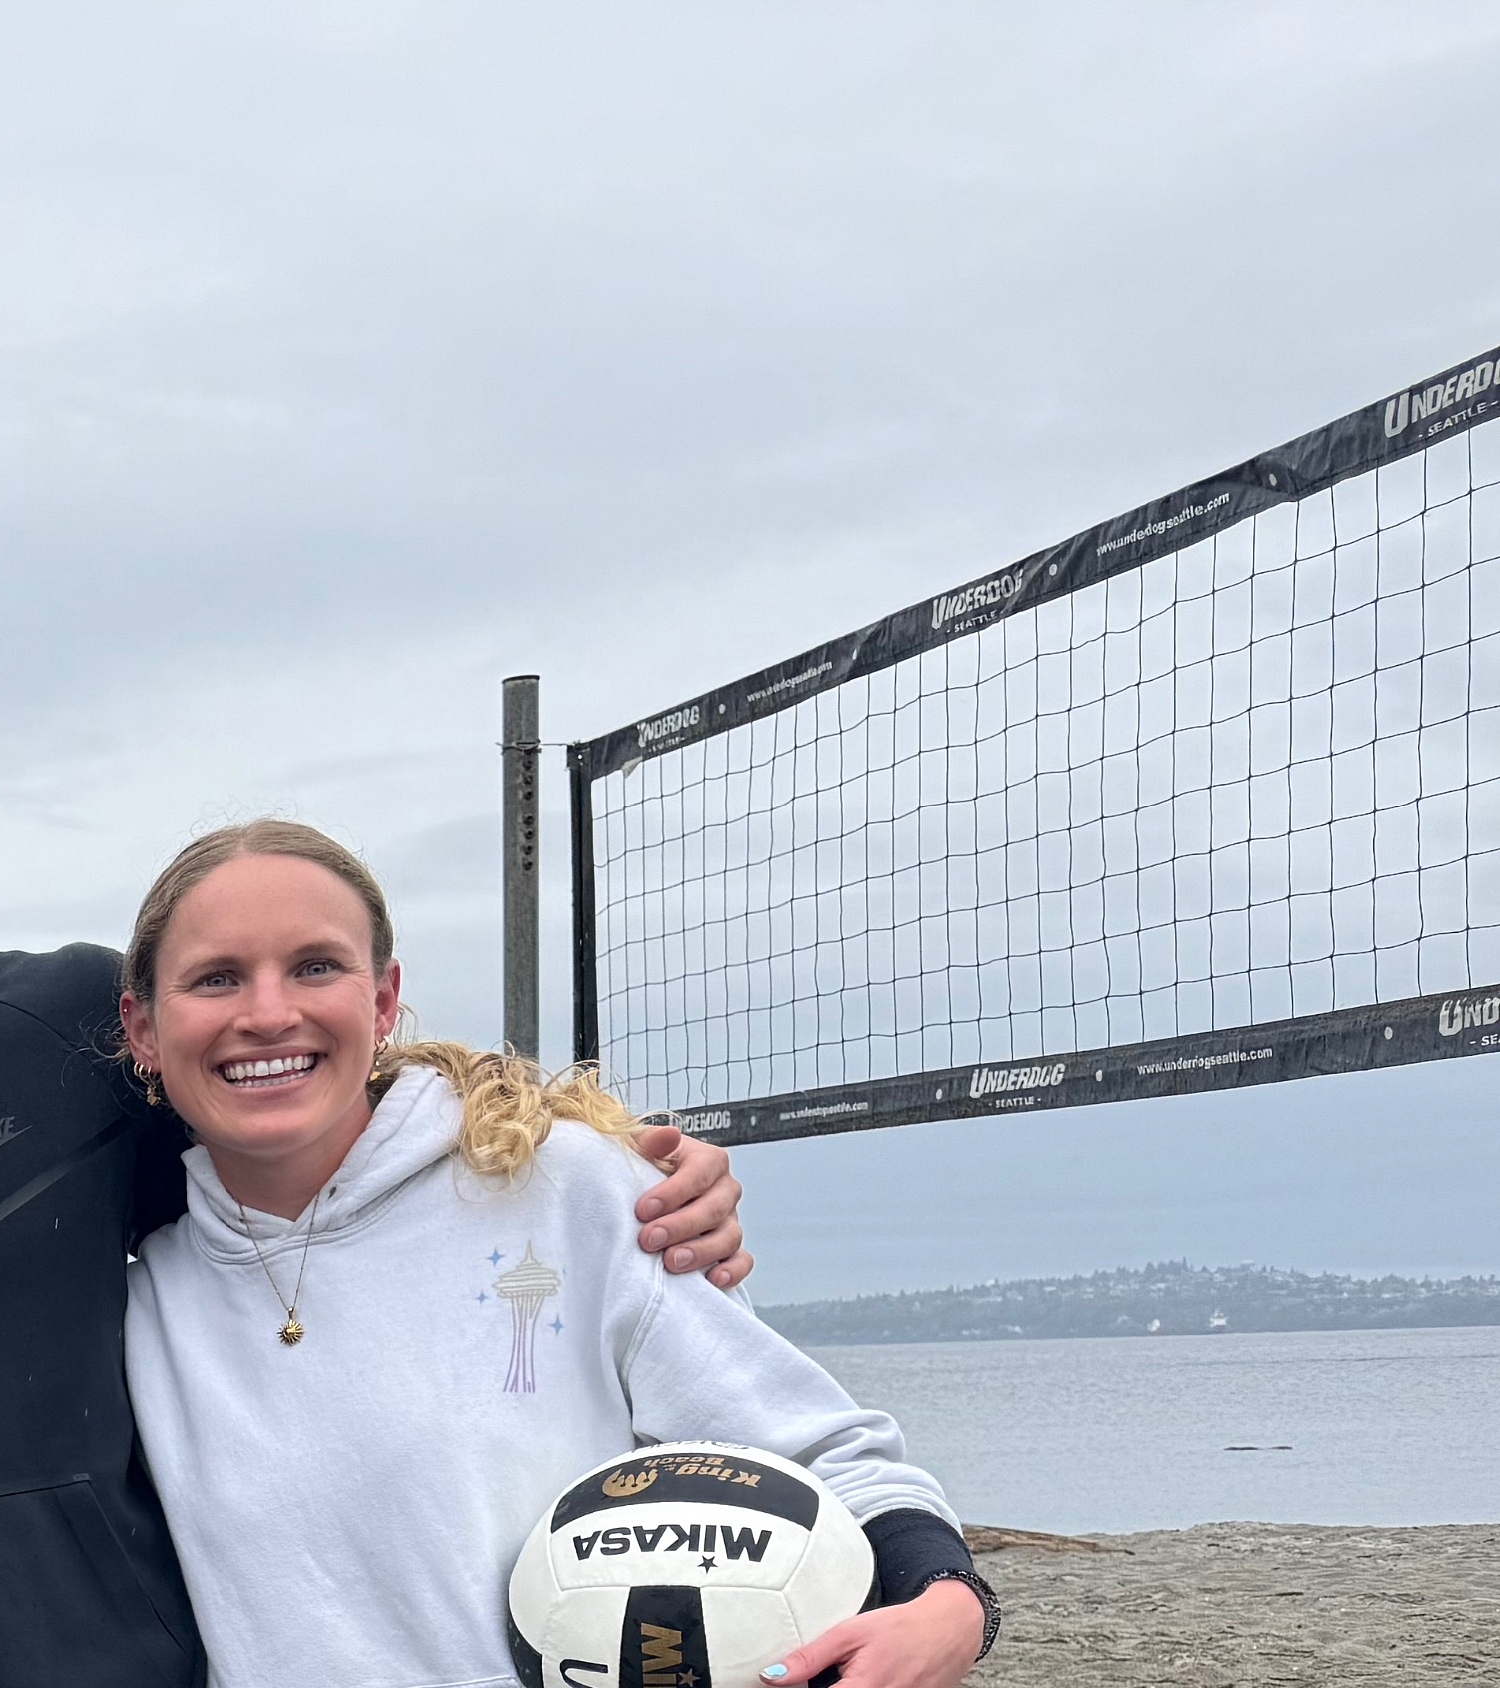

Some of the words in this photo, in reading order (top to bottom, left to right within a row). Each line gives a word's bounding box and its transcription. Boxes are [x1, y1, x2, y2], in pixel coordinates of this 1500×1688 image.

[1427, 401, 1488, 437] SEATTLE
[954, 609, 999, 633] SEATTLE
[969, 1063, 1066, 1099] UNDERDOG
[995, 1096, 1035, 1109] SEATTLE
[674, 1463, 762, 1488] King
[572, 1523, 773, 1563] MIKASA
